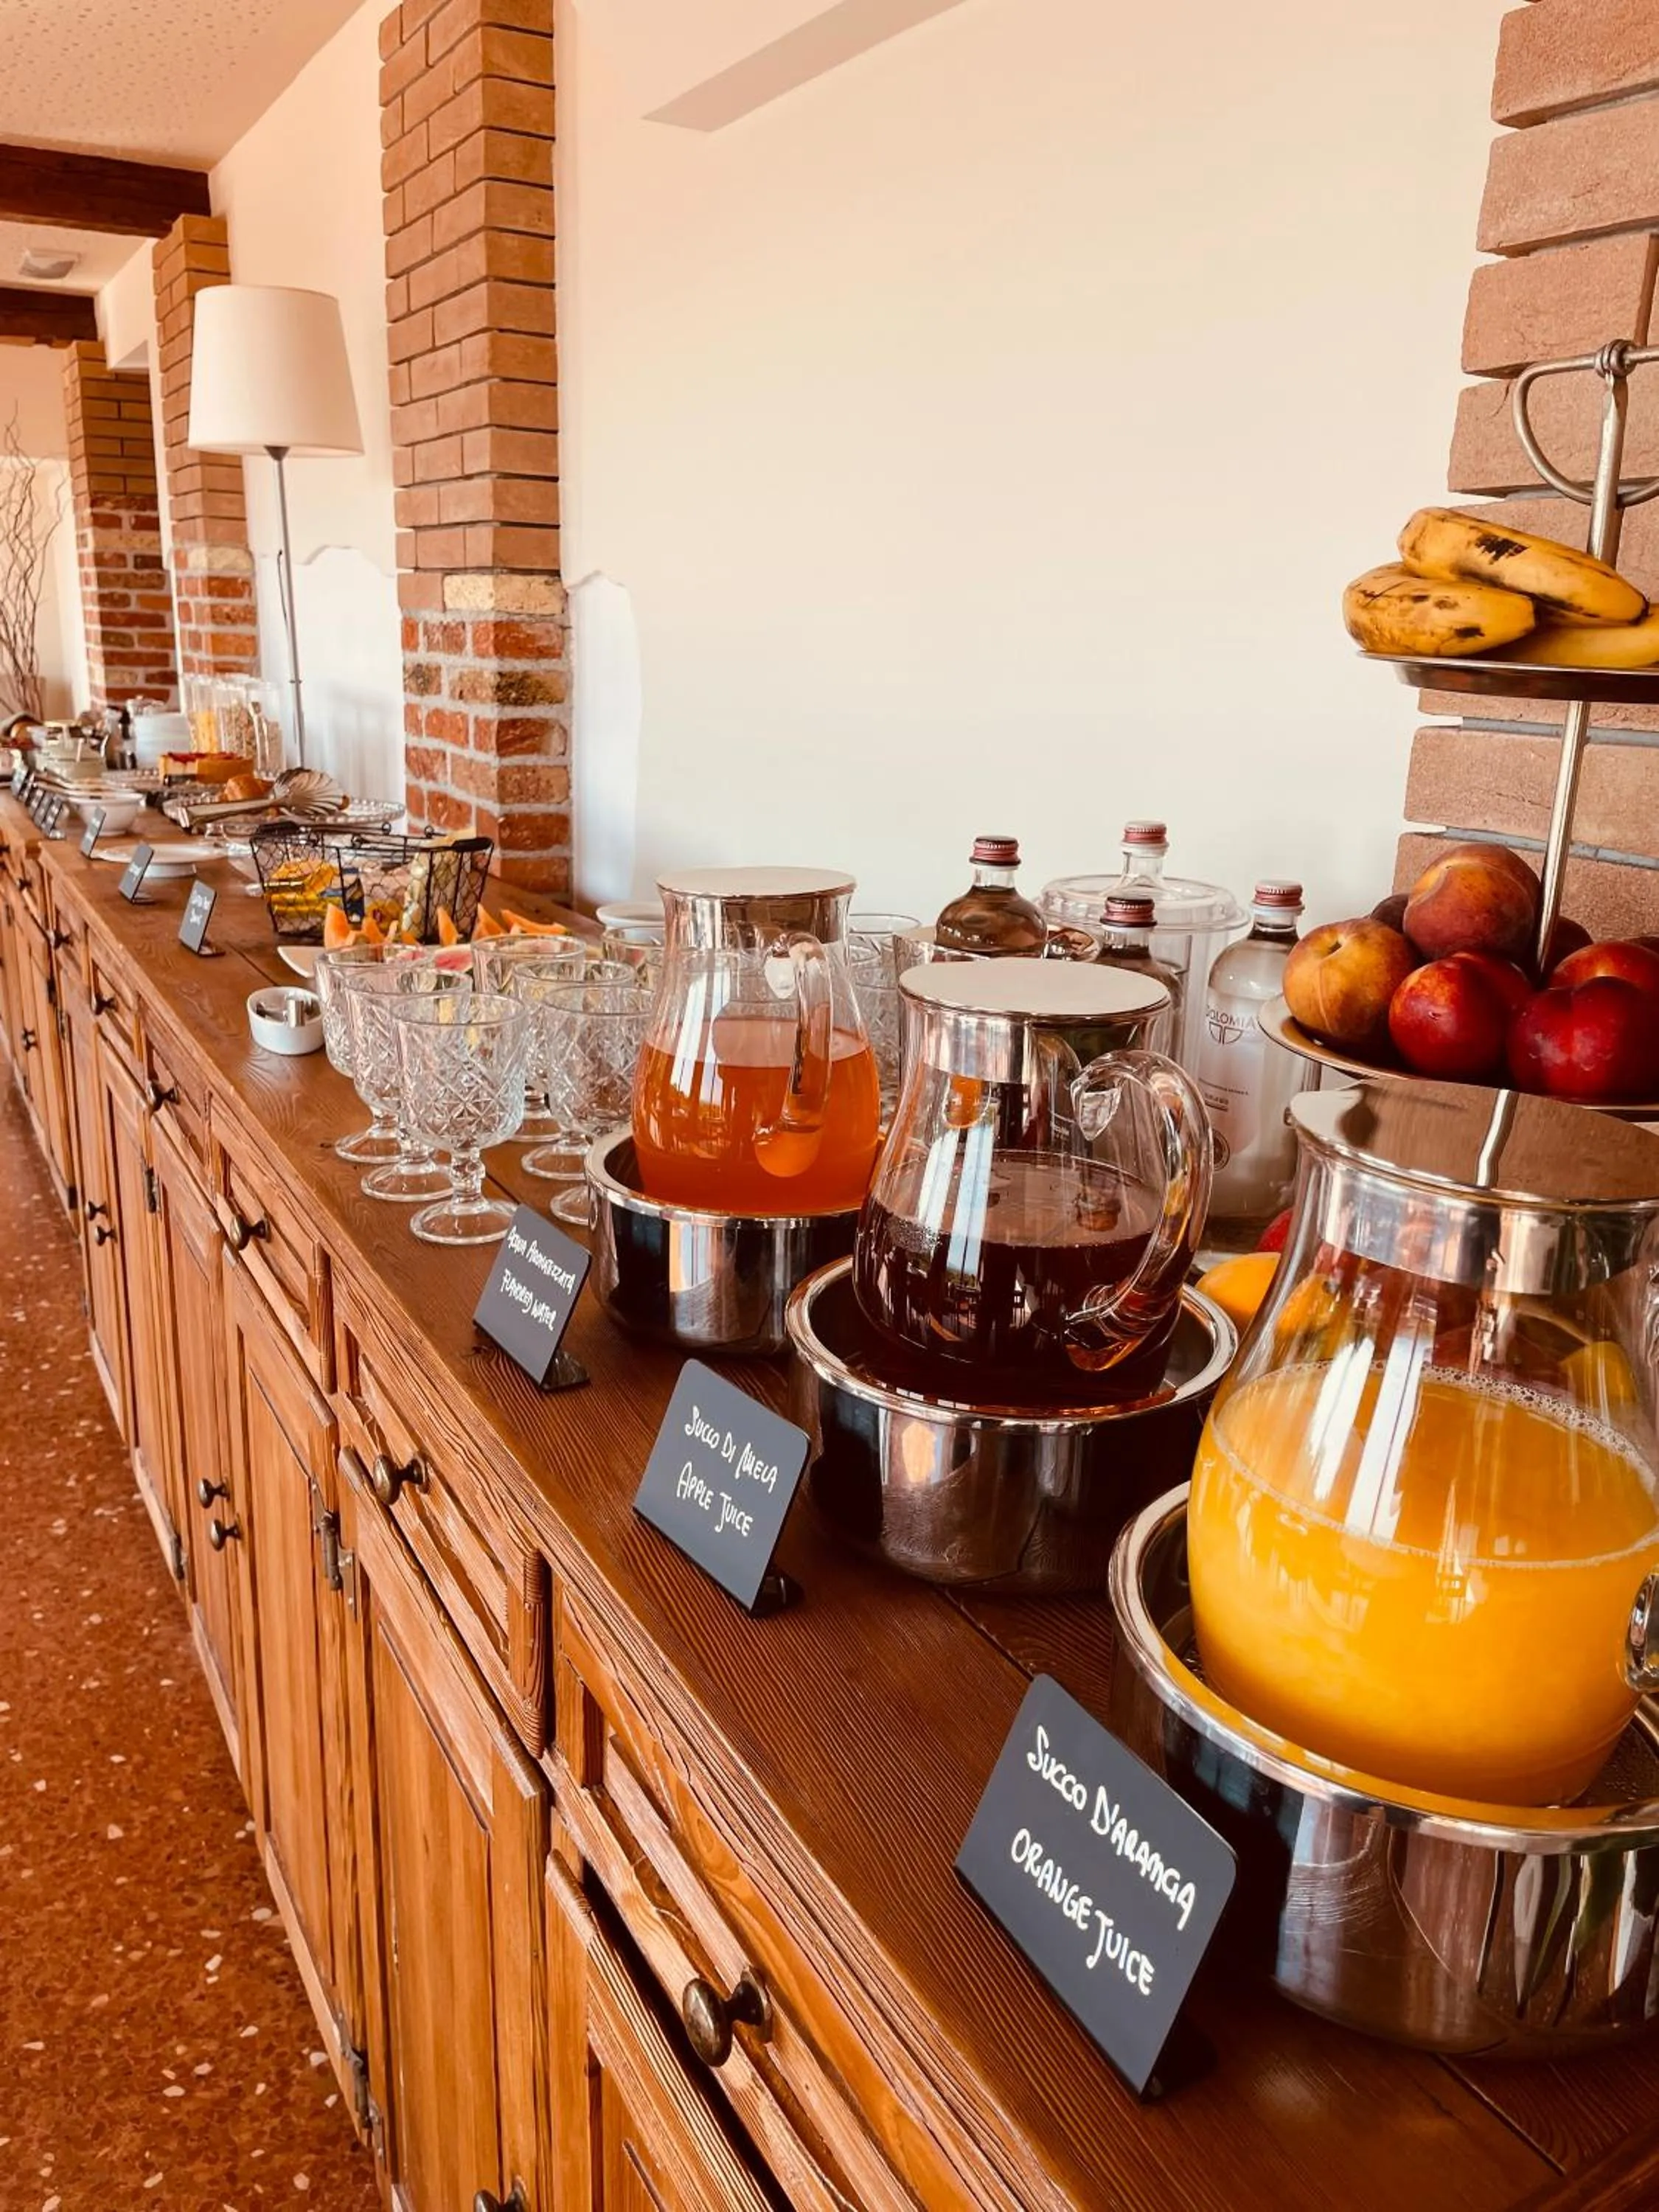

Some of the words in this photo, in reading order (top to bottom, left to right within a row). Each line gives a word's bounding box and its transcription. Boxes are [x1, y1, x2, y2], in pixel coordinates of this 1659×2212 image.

[675, 1461, 715, 1511] APPLE
[714, 1492, 754, 1537] JUICE
[1011, 1828, 1093, 1930] ORANGE
[1085, 1909, 1155, 1996] JUICE
